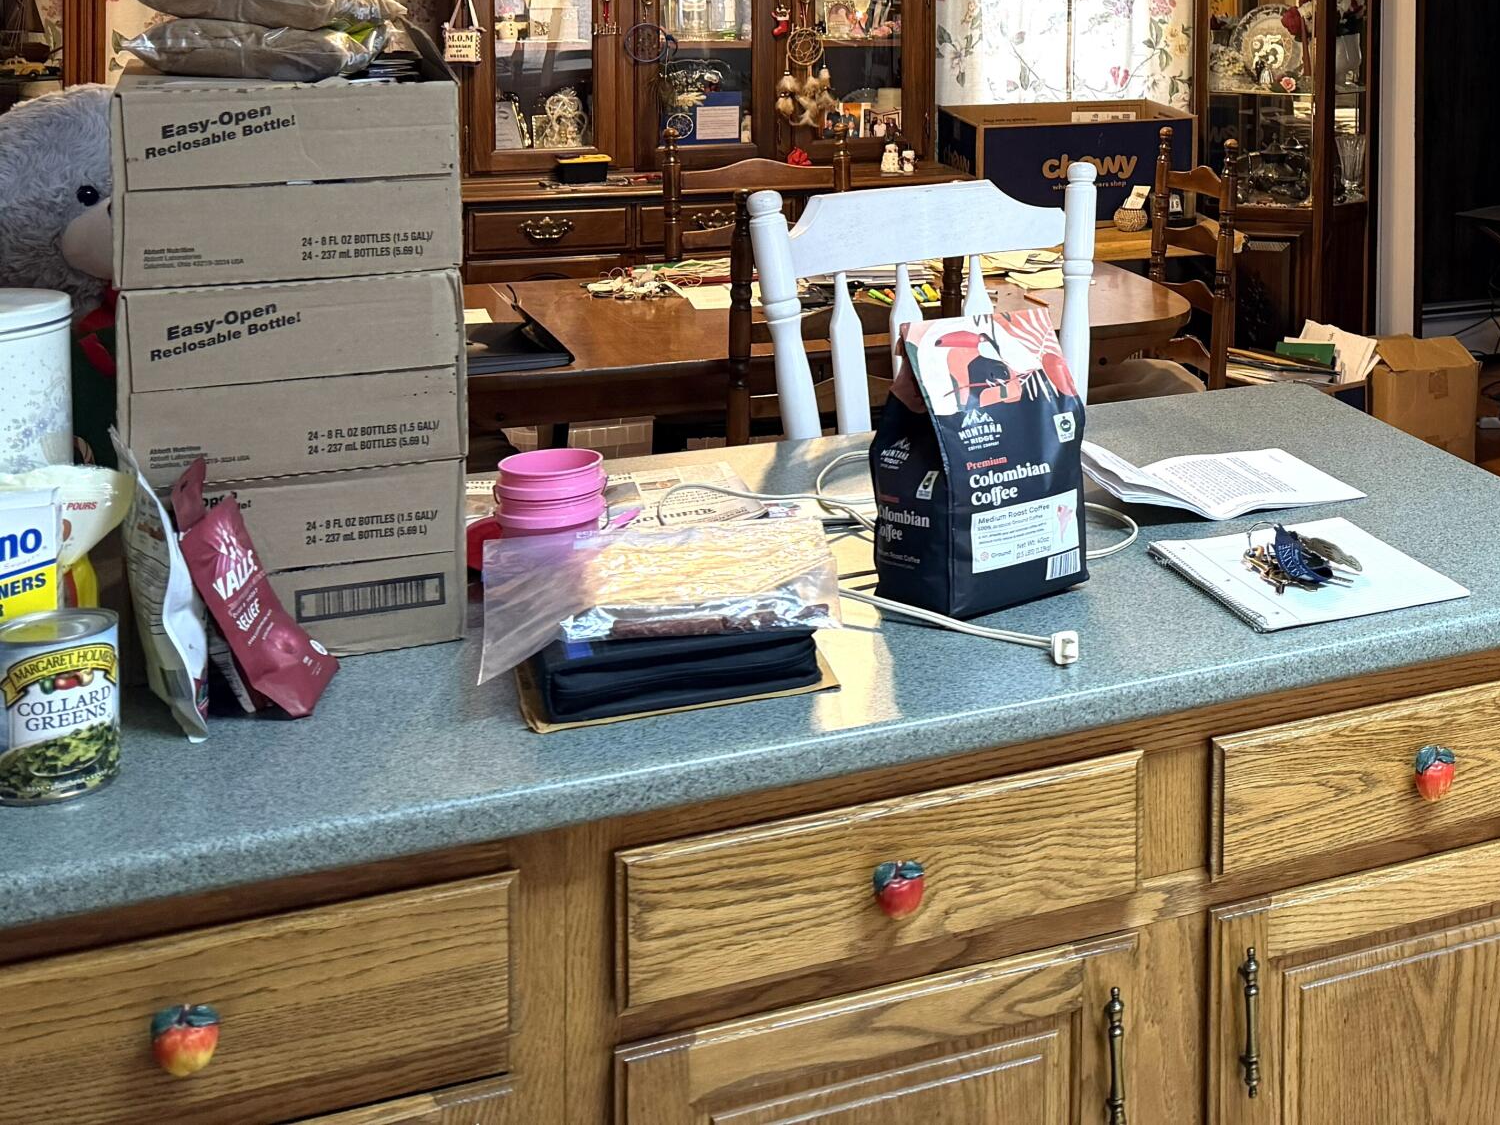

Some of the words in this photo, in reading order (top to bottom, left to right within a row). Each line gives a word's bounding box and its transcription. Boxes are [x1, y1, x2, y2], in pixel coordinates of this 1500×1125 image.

[447, 34, 474, 43] M.O.M
[161, 105, 272, 139] Easy-Open
[145, 130, 237, 160] Reclosable
[242, 114, 296, 137] Bottle!
[302, 237, 312, 246] 24
[329, 236, 339, 245] FL
[341, 235, 352, 244] OZ
[354, 233, 391, 244] BOTTLES
[393, 232, 409, 243] (1.5
[302, 251, 312, 261] 24
[321, 250, 337, 260] 237
[339, 249, 352, 259] mL
[354, 247, 391, 258] BOTTLES
[167, 303, 277, 341] Easy-Open
[150, 330, 242, 362] Reclosable
[247, 311, 302, 336] Bottle!
[308, 431, 318, 441] 24
[335, 429, 345, 438] FL
[348, 428, 358, 437] OZ
[360, 424, 397, 436] BOTTLES
[400, 423, 415, 435] (1.5
[417, 420, 440, 433] GAL)/
[958, 423, 1002, 440] MONTAÑA
[970, 435, 994, 445] RIDGE
[308, 445, 318, 454] 24
[327, 444, 343, 453] 237
[345, 443, 358, 451] mL
[360, 438, 397, 450] BOTTLES
[966, 456, 1008, 471] Premium
[969, 462, 1051, 489] Colombian
[66, 501, 97, 511] POURS
[971, 485, 1018, 506] Coffee
[306, 521, 316, 531] 24
[333, 519, 343, 528] FL
[345, 518, 356, 527] OZ
[358, 514, 395, 526] BOTTLES
[397, 512, 412, 524] (1.5
[415, 510, 438, 521] GAL)/
[978, 513, 1007, 525] Medium
[1008, 509, 1028, 518] Roast
[1029, 504, 1050, 514] Coffee
[306, 536, 316, 545] 24
[325, 533, 340, 543] 237
[343, 532, 356, 541] mL
[358, 528, 394, 540] BOTTLES
[991, 549, 1012, 559] Ground
[13, 652, 75, 681] MARGARET
[77, 649, 115, 667] HOLMES
[17, 685, 111, 717] COLLARD
[25, 703, 106, 732] GREENS
